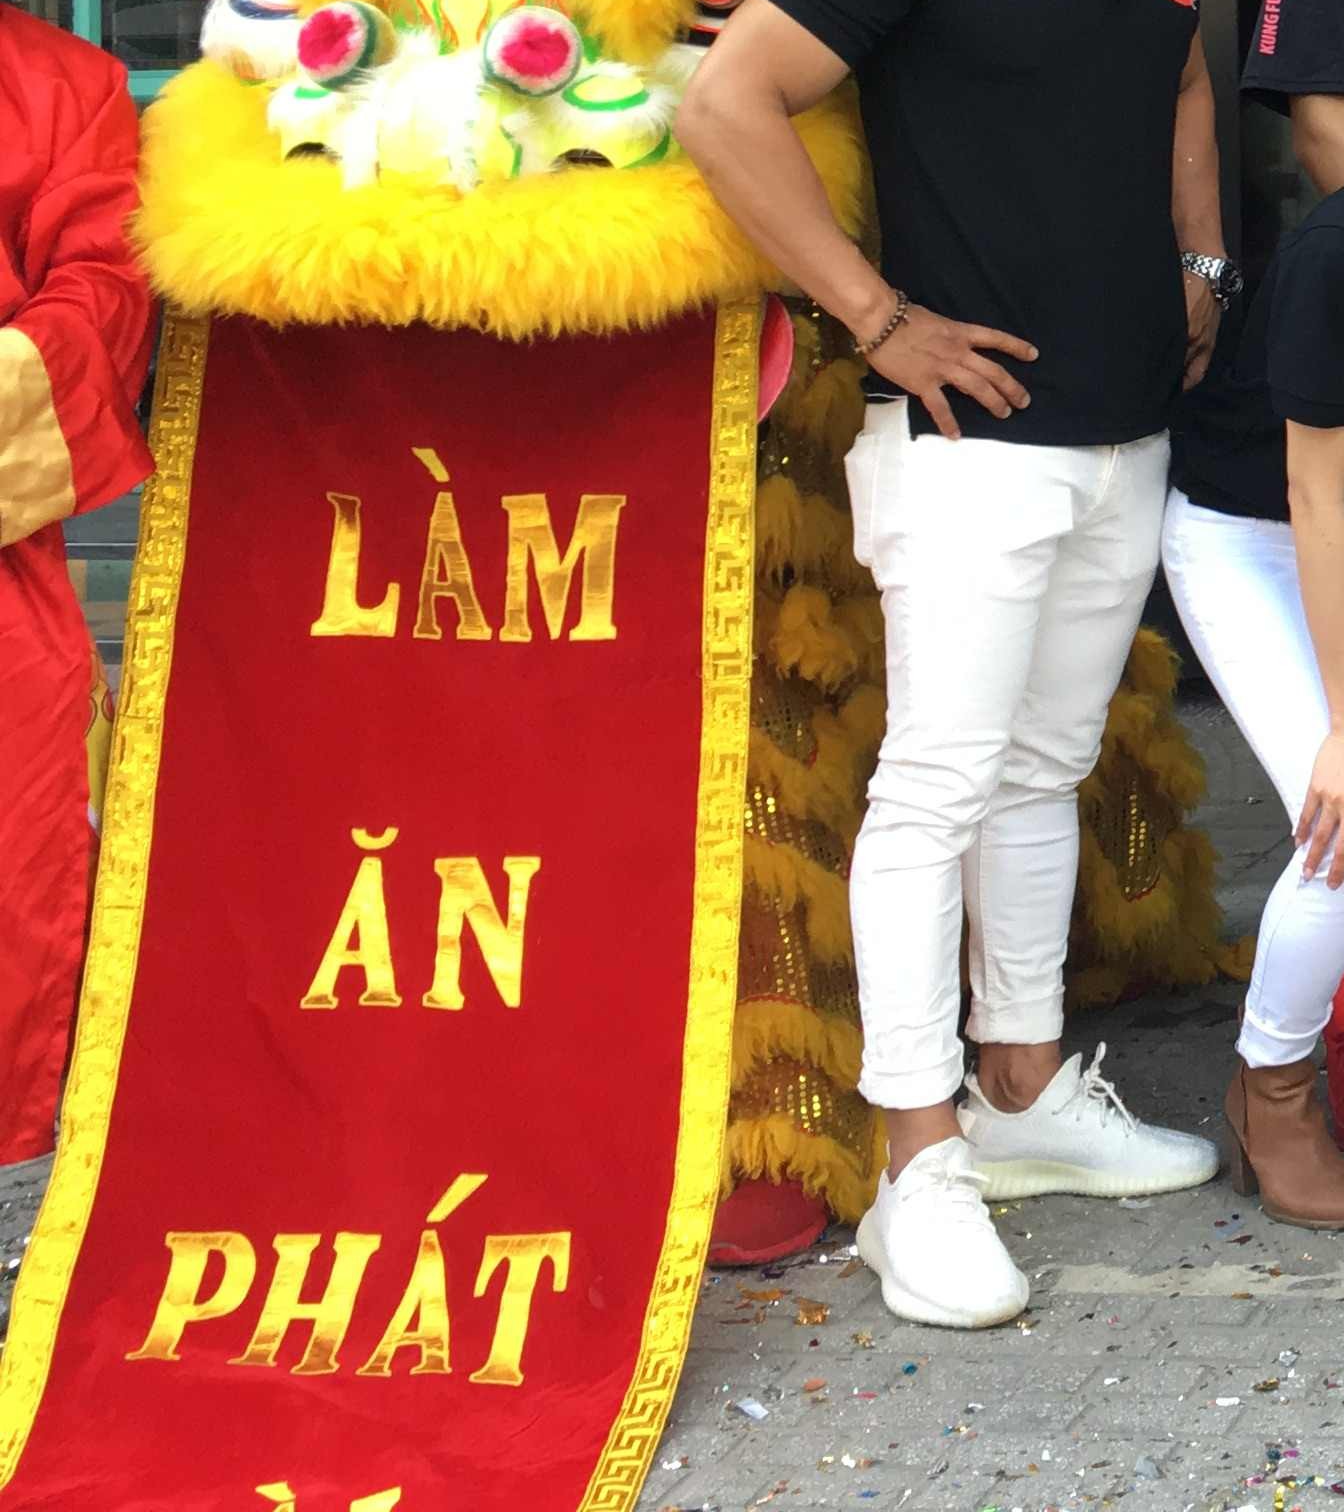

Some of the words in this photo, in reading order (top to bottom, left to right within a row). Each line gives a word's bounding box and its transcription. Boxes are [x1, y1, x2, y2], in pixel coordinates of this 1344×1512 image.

[1258, 13, 1279, 56] KUNG
[309, 446, 627, 642] LÀM
[300, 826, 542, 1011] ĂN
[125, 1173, 573, 1387] PHÁT
